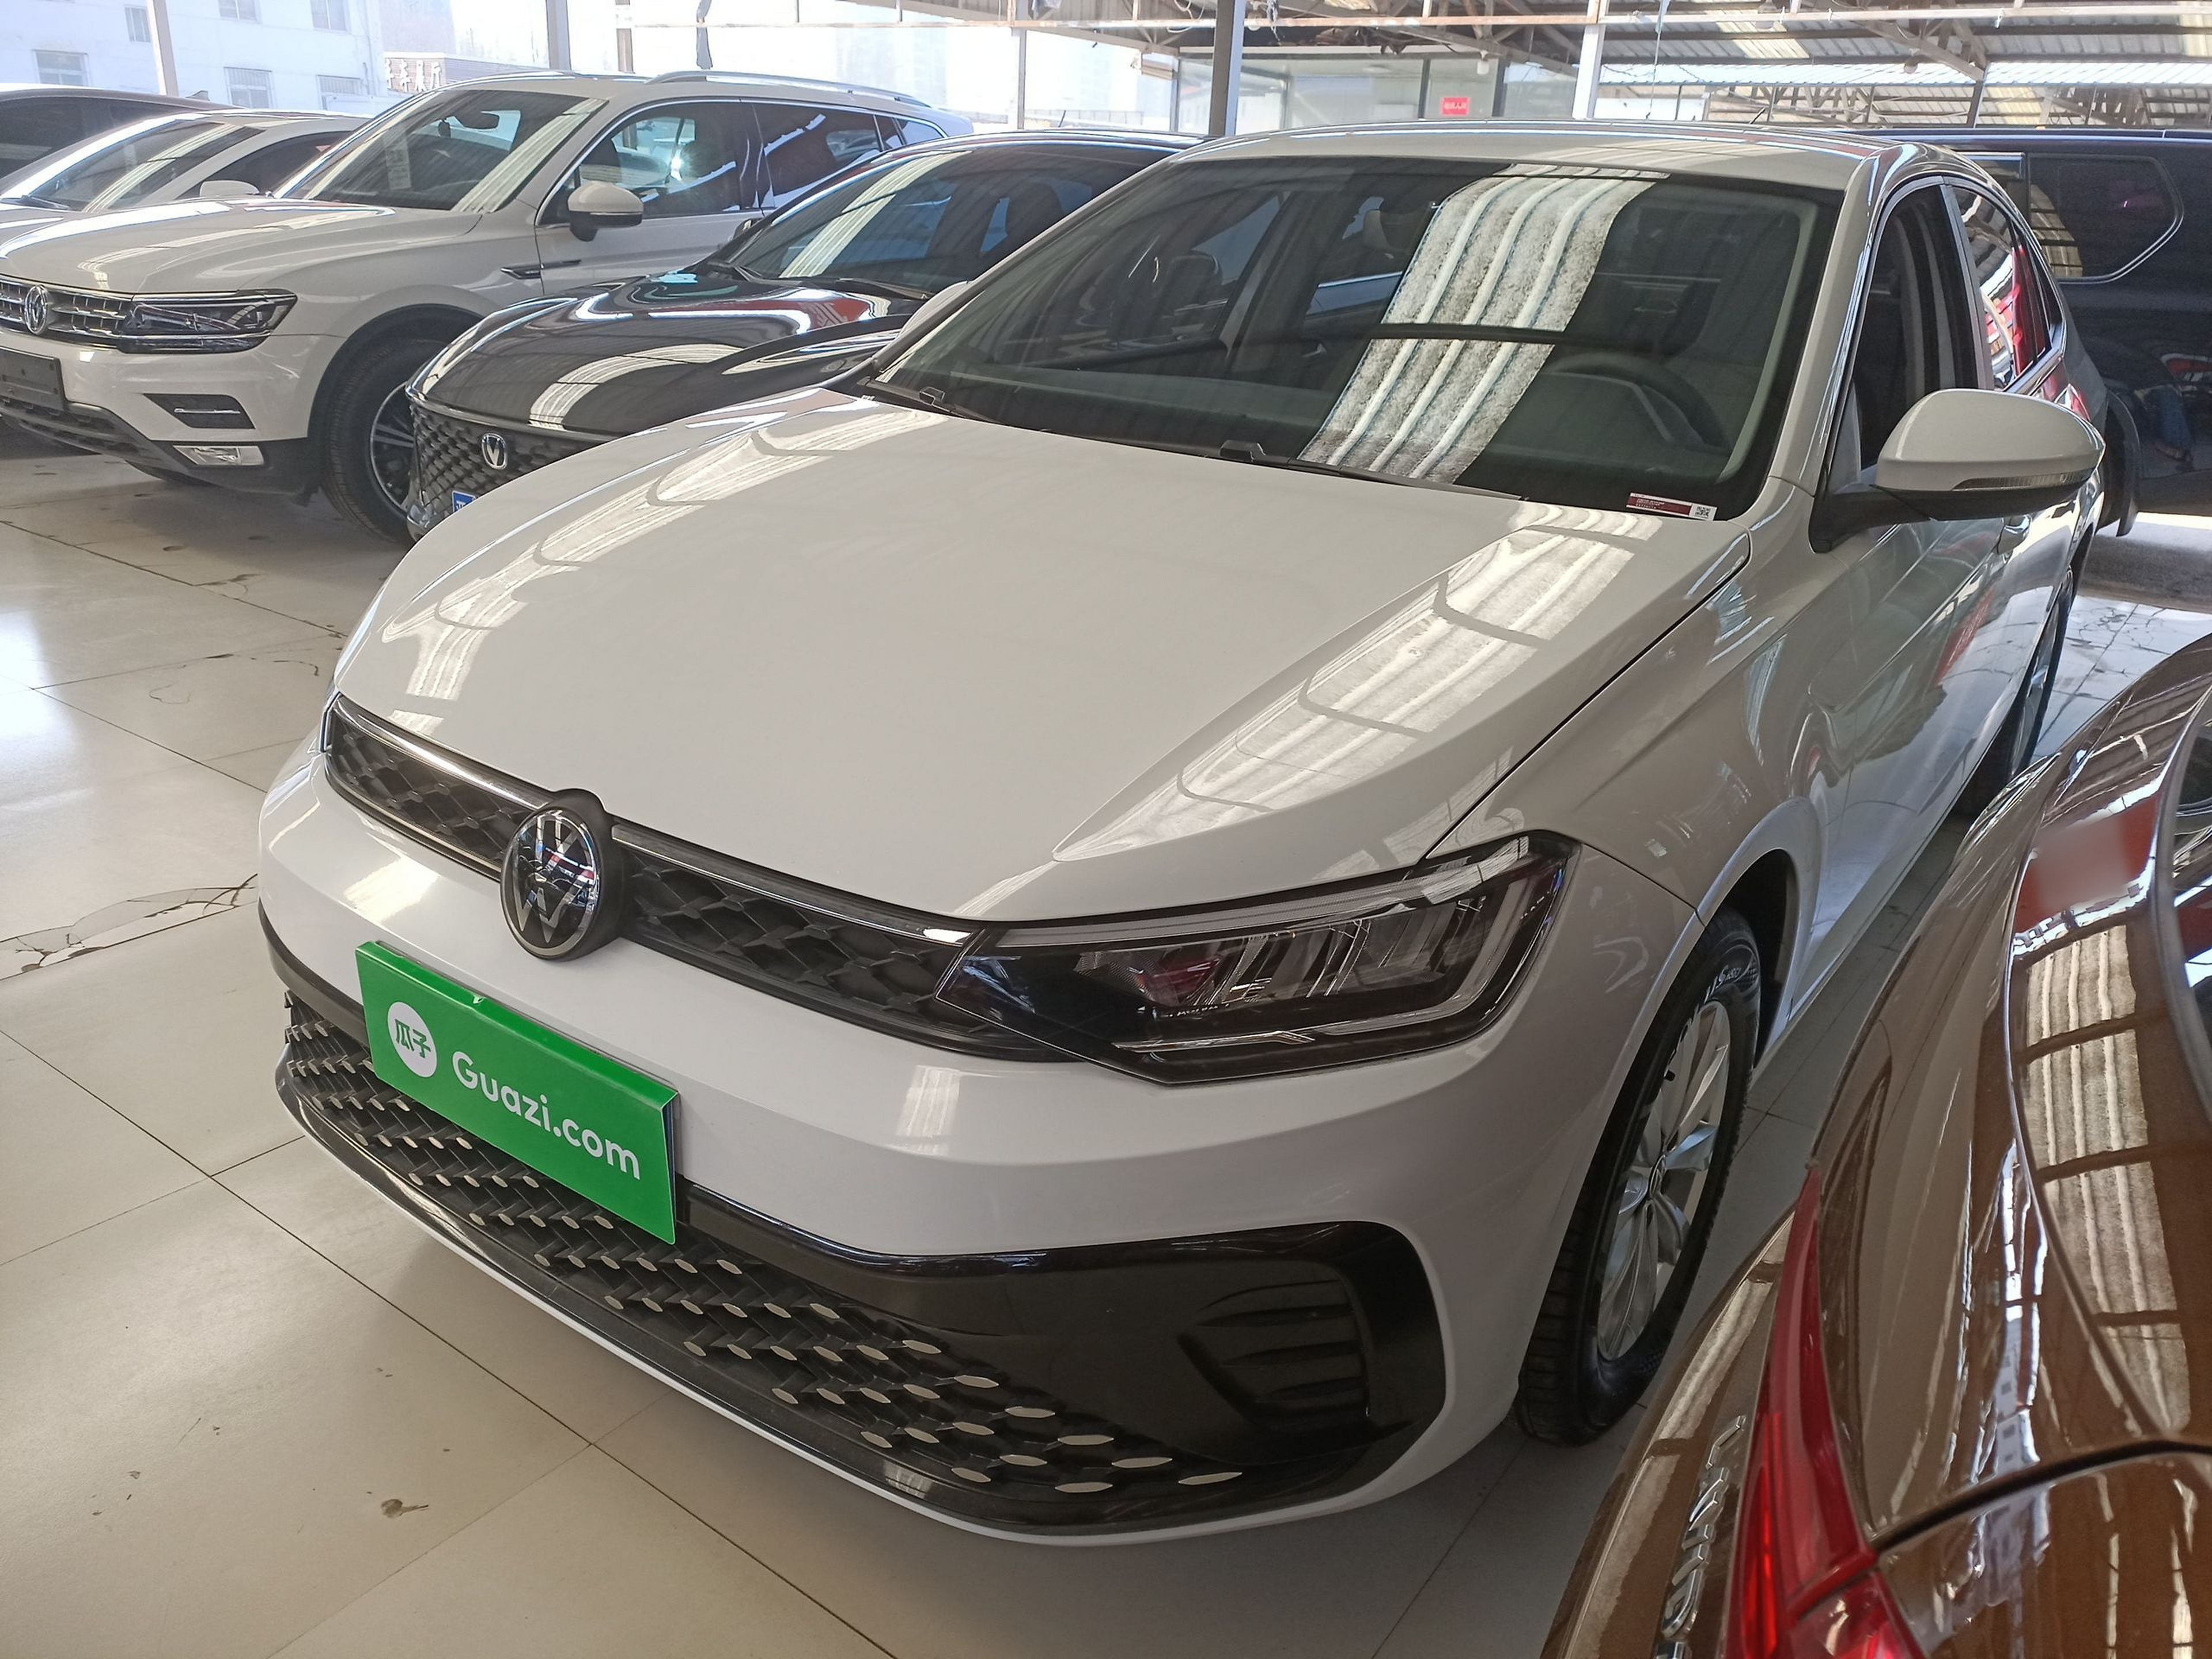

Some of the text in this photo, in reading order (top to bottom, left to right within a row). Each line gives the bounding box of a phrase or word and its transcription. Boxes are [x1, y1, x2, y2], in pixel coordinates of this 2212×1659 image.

[394, 1018, 431, 1059] 瓜子
[452, 1051, 641, 1181] Guazi.com
[1657, 1415, 1747, 1659] LAVID
